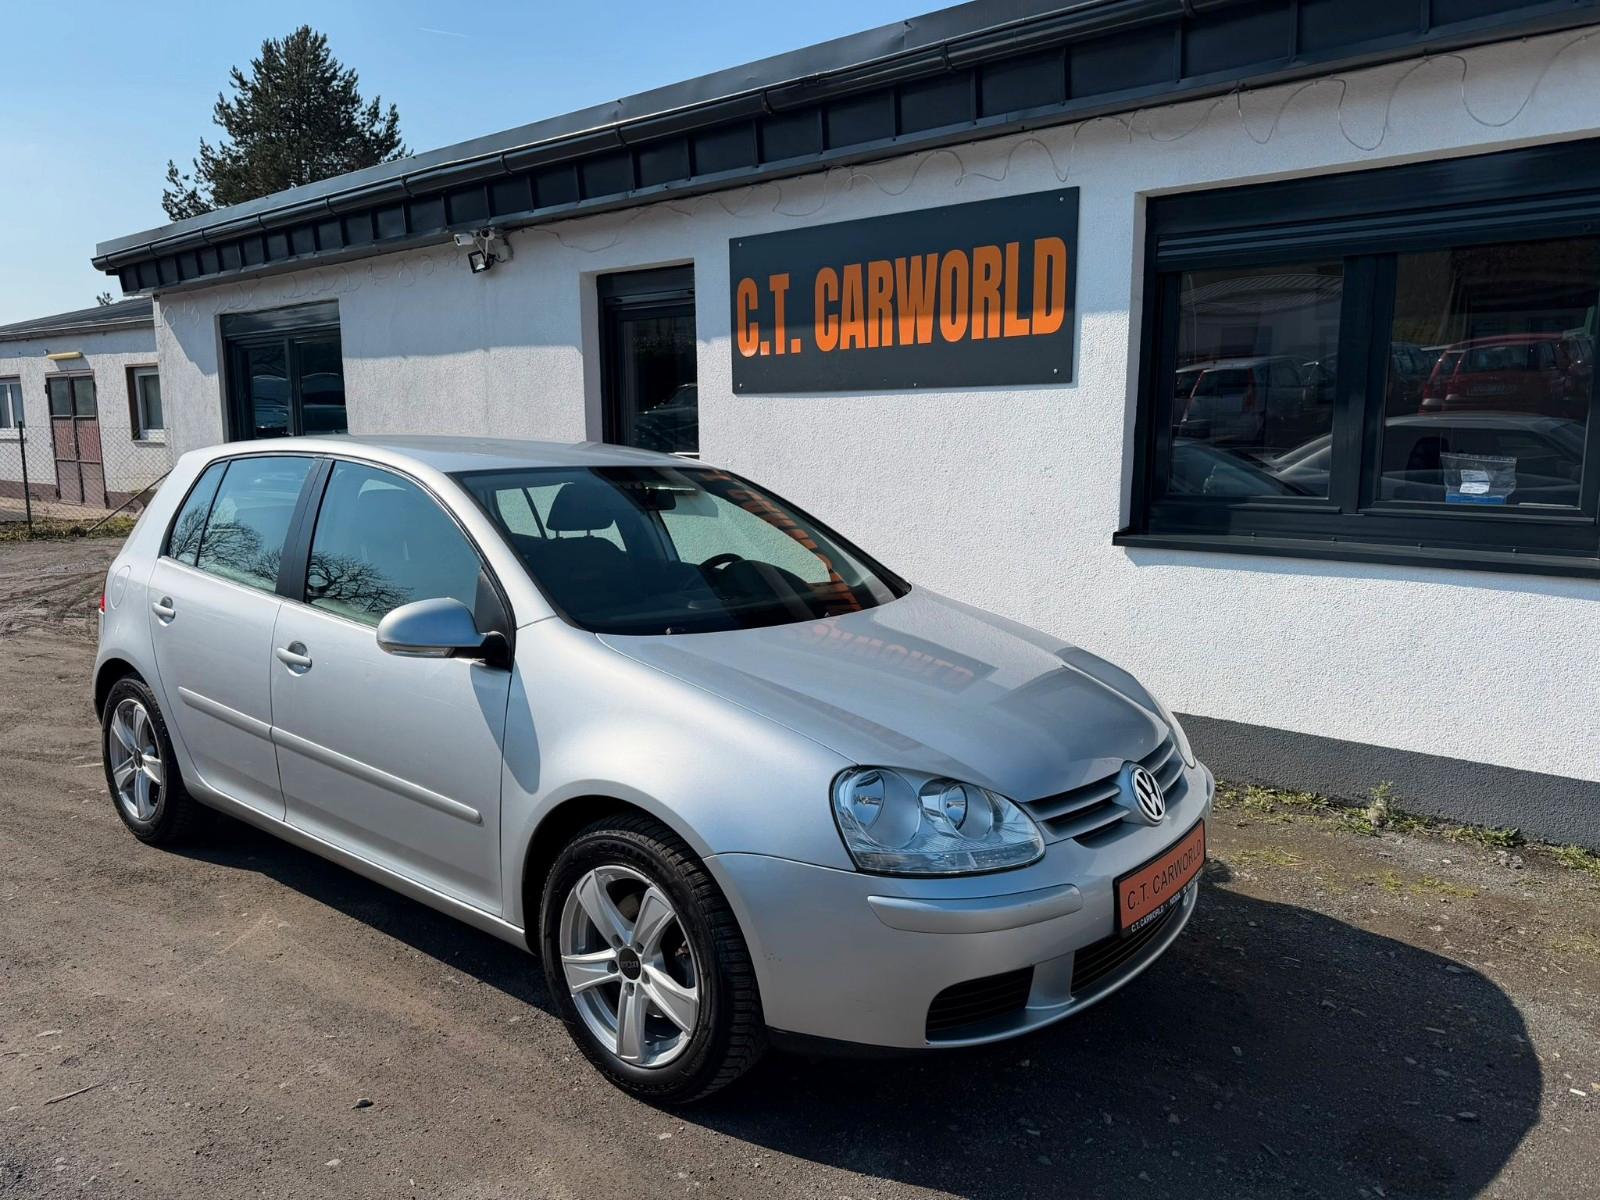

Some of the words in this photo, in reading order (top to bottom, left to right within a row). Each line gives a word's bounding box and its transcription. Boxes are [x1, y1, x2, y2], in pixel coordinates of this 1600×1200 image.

[737, 272, 801, 357] C.T.
[814, 236, 1067, 352] CARWORLD
[1128, 883, 1150, 910] C.T.
[1152, 839, 1201, 894] CARWORLD
